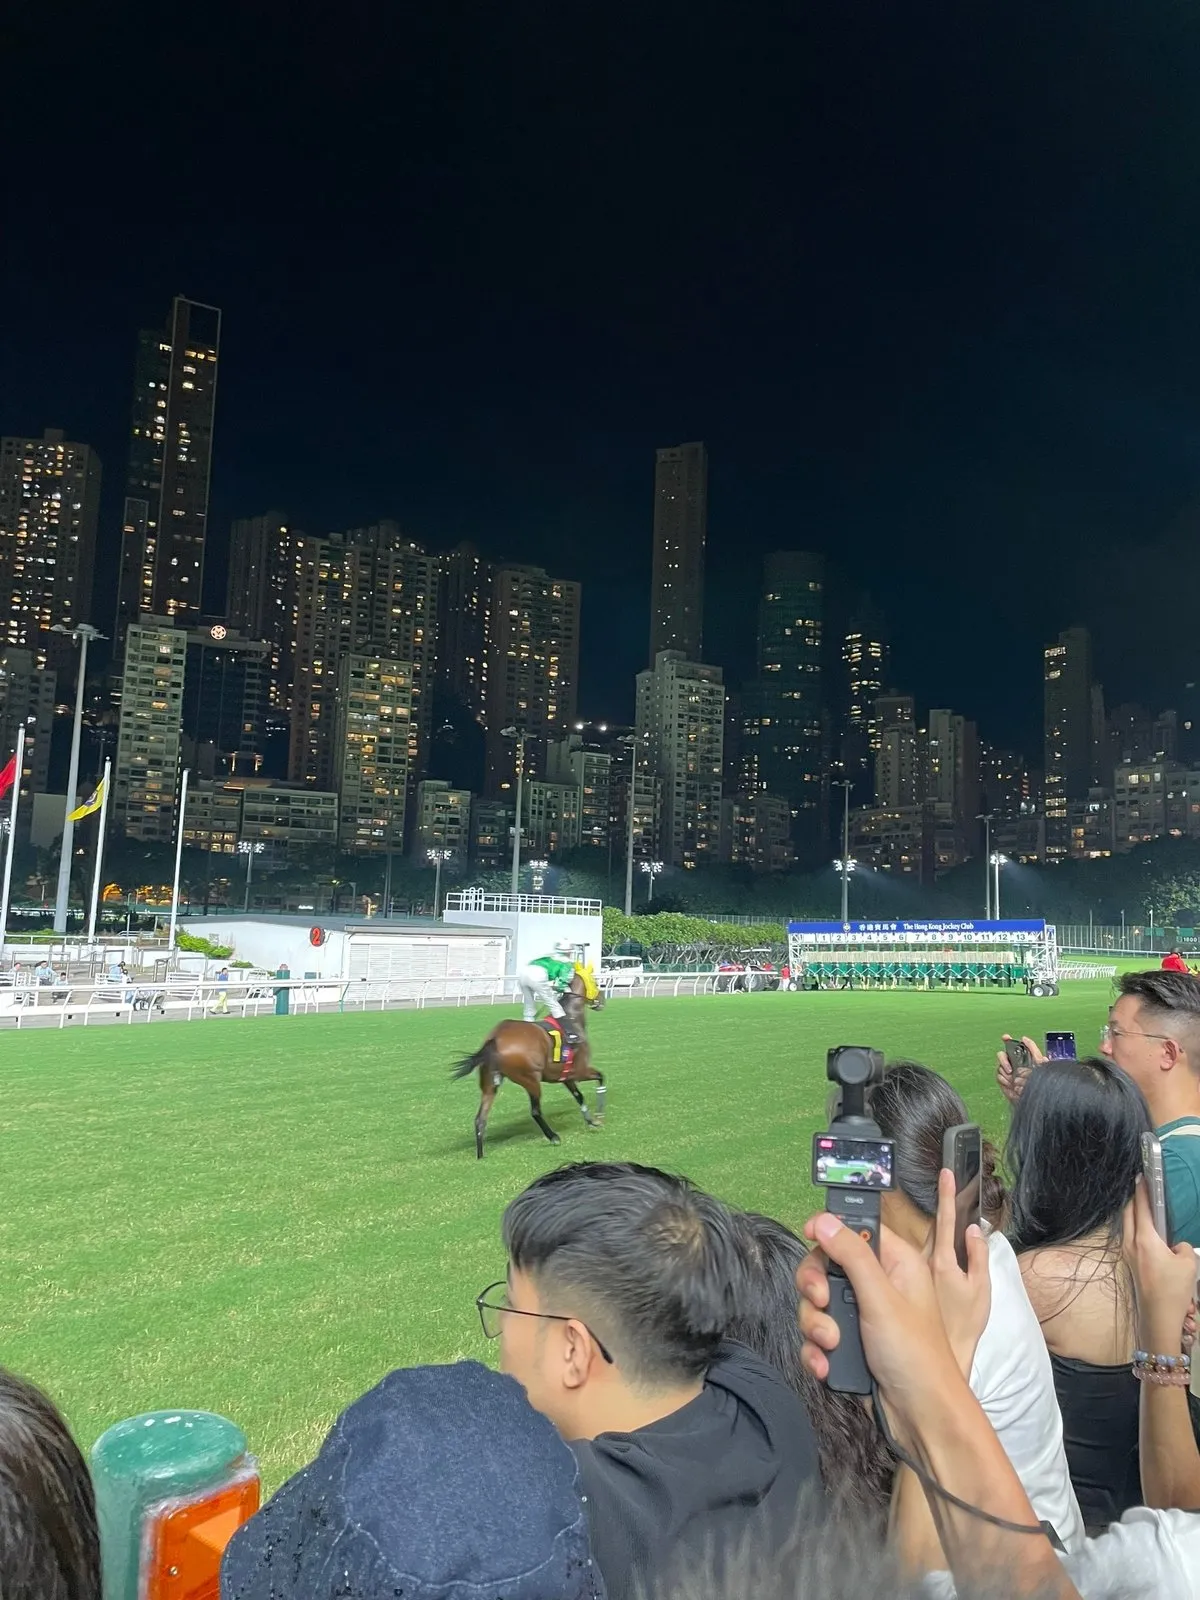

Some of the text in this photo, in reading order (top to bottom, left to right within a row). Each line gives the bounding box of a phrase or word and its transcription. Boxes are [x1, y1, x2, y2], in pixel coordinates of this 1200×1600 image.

[914, 923, 928, 931] Hong
[942, 922, 960, 931] Jockey
[961, 922, 974, 930] Club
[312, 928, 320, 944] 2
